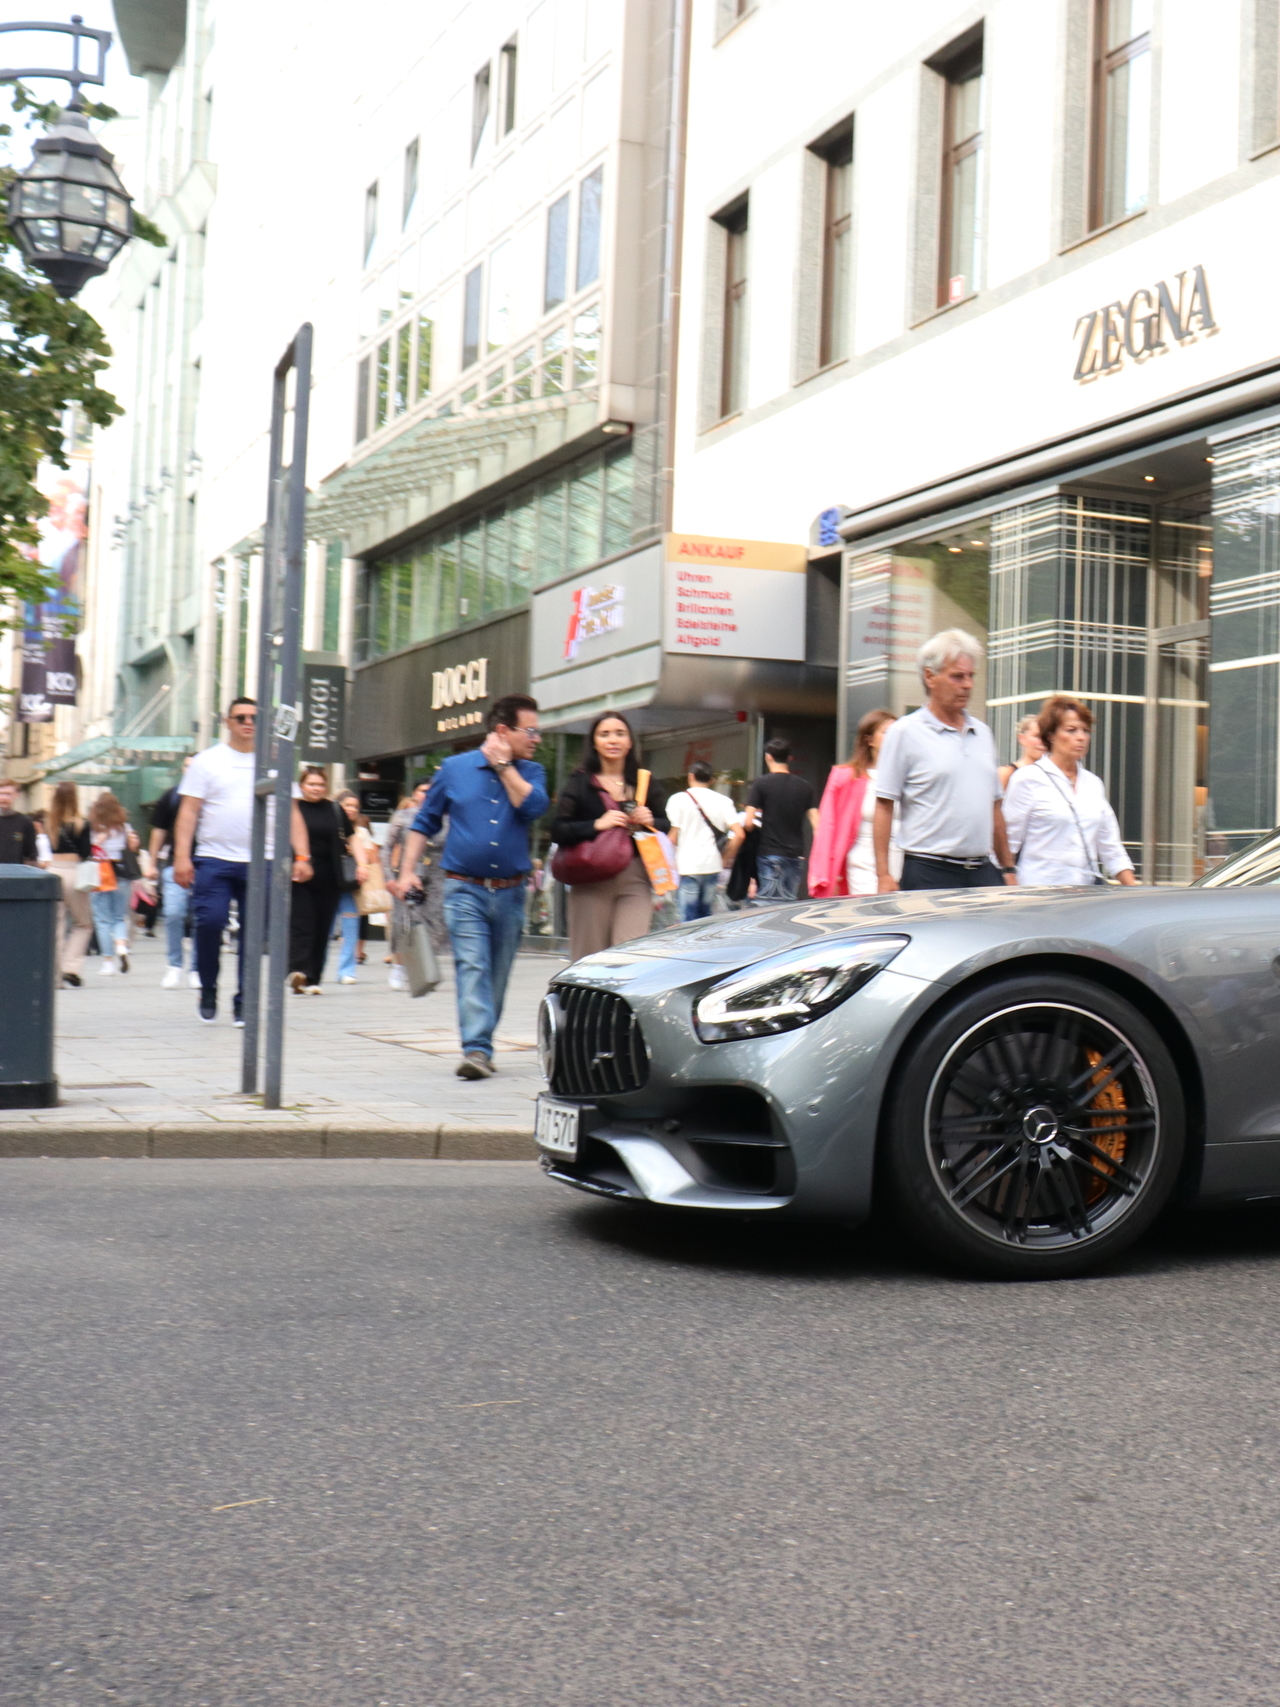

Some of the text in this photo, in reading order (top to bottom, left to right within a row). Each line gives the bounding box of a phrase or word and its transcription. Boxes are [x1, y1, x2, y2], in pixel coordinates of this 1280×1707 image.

[1073, 264, 1217, 380] ZEGNA
[678, 542, 745, 560] ANKAUF
[676, 571, 713, 583] Uhren
[676, 586, 732, 600] Schmuck
[676, 602, 734, 616] Brillanten
[676, 618, 738, 632] Edelsteine
[676, 634, 721, 648] Altgold
[430, 658, 488, 710] BOGGI
[308, 678, 331, 748] BOGGI
